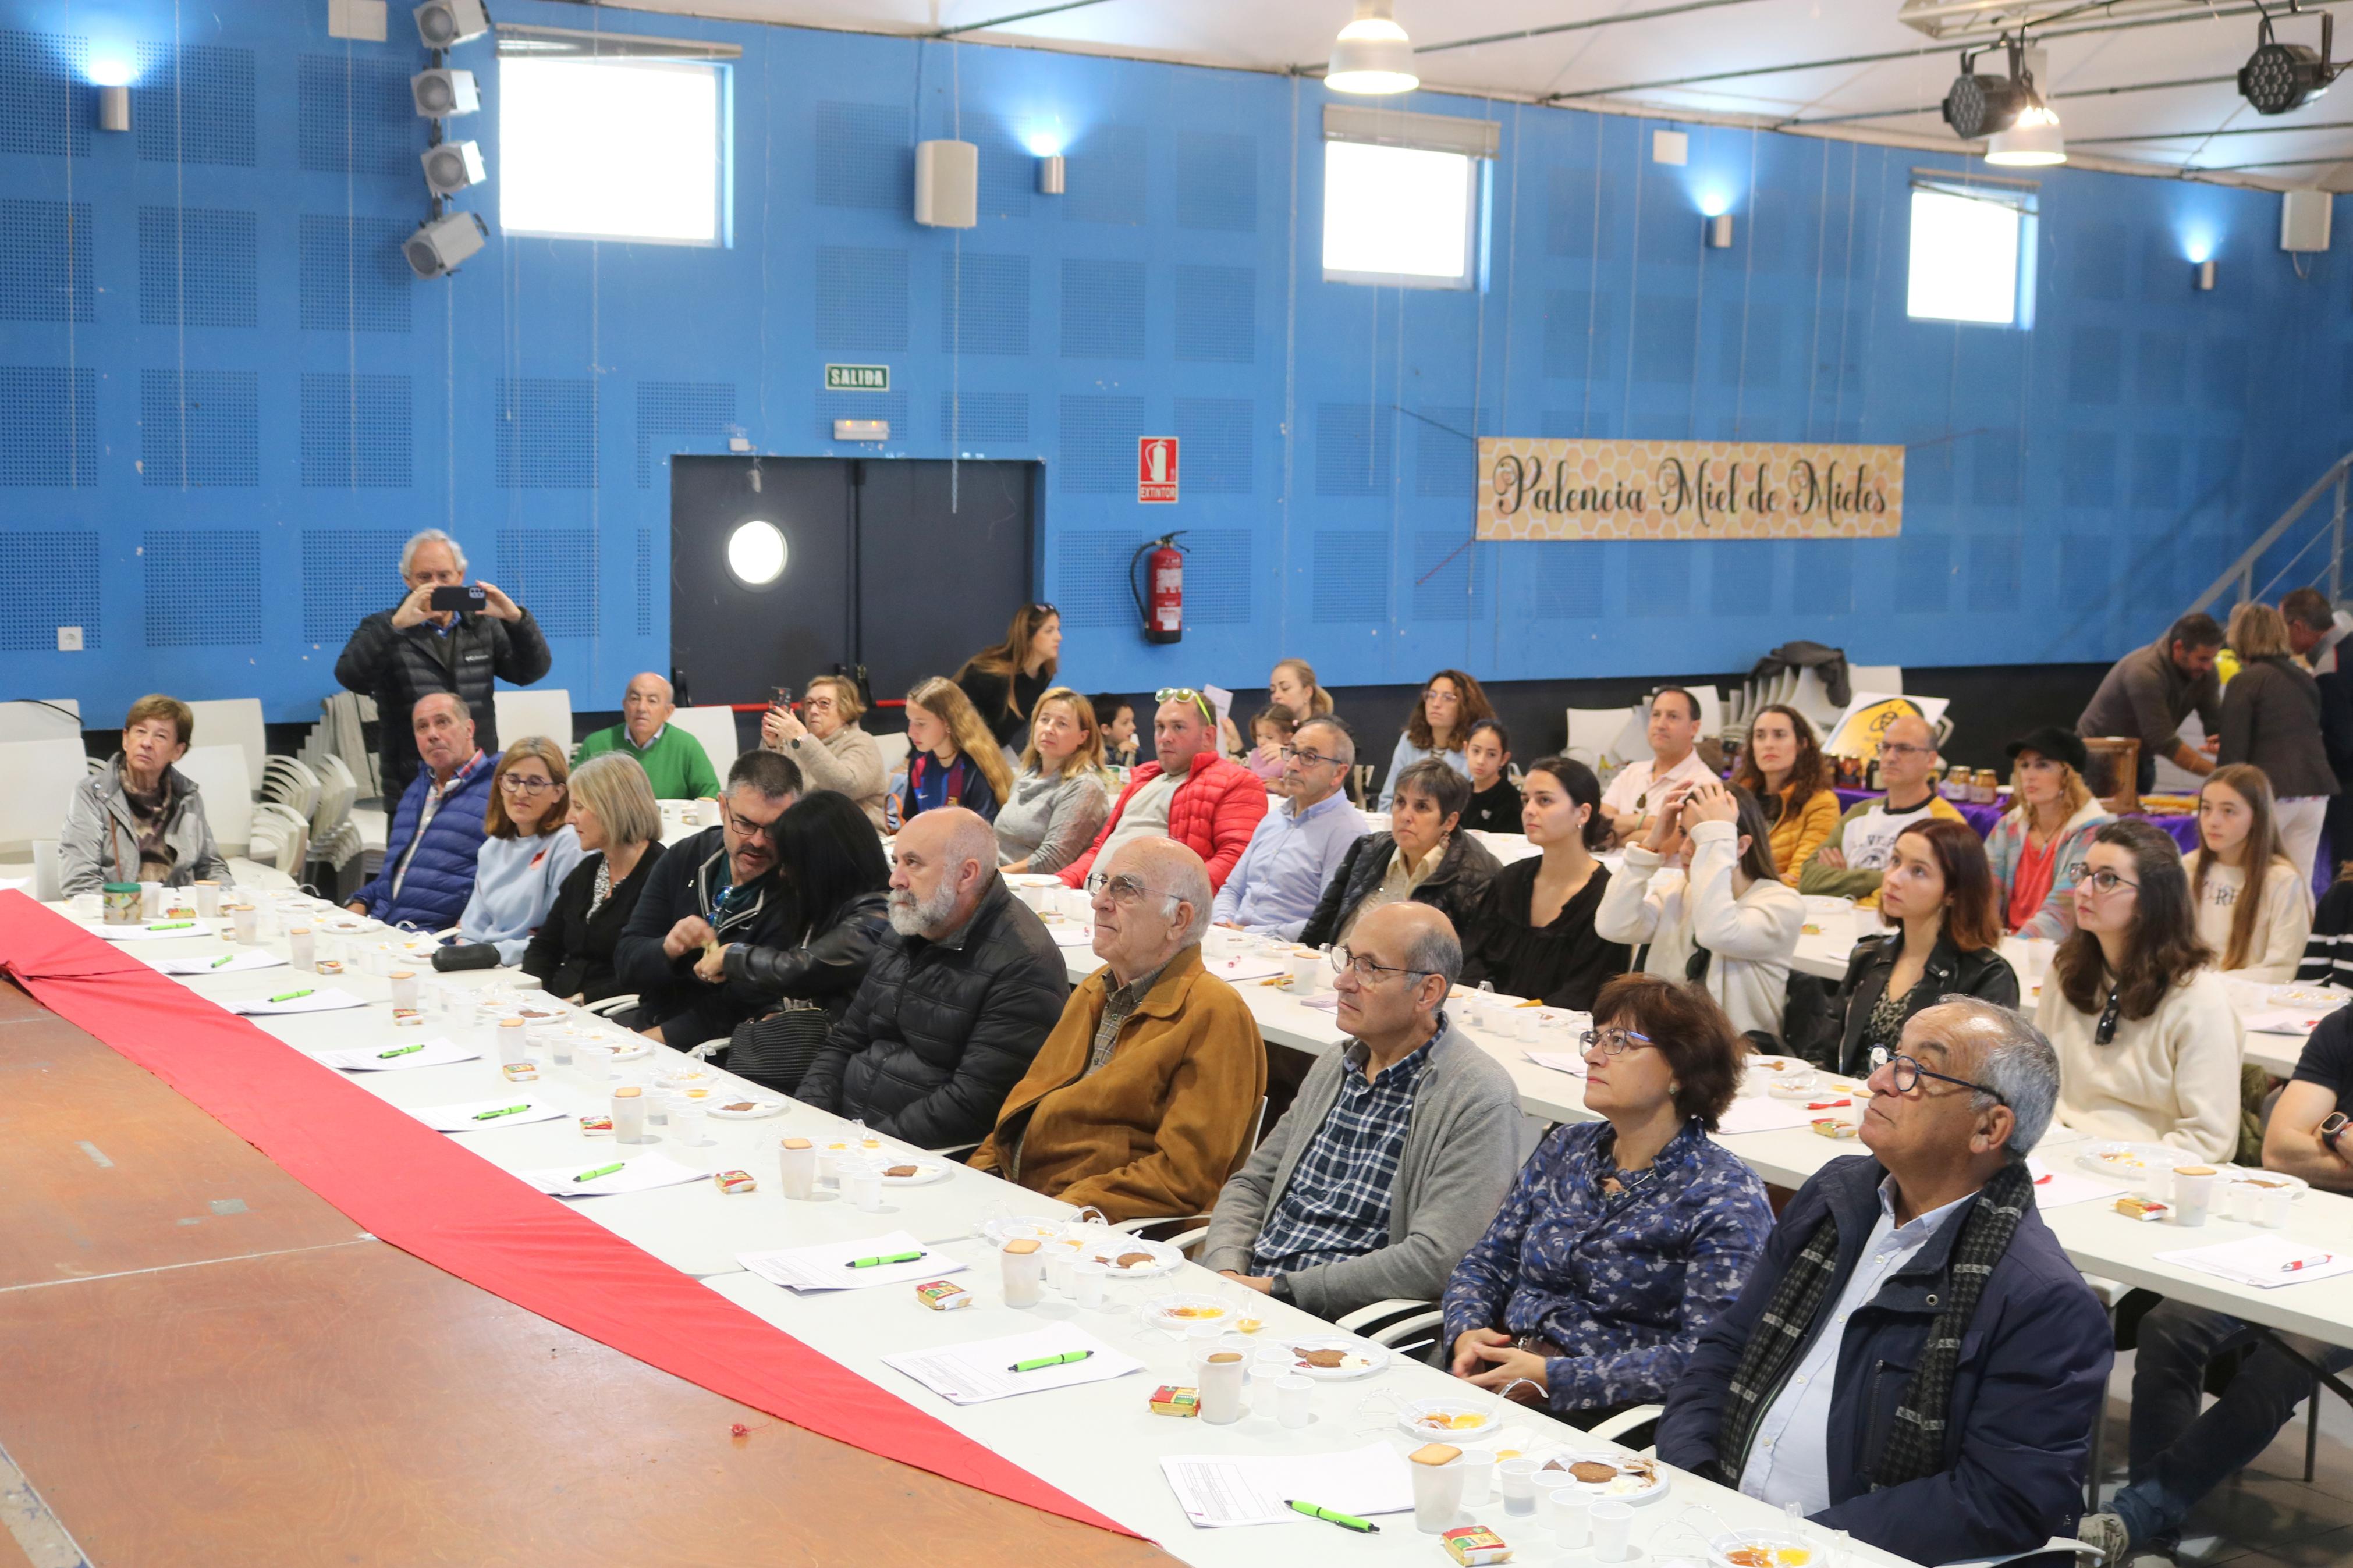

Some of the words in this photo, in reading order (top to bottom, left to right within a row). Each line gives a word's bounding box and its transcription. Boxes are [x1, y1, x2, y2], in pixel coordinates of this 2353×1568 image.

[831, 368, 884, 386] SALIDA
[1140, 486, 1176, 499] EXTINTOR
[1492, 454, 1644, 514] Palencia
[1656, 456, 1738, 528] Miel
[1747, 462, 1779, 513] de
[1788, 458, 1887, 527] Mieles
